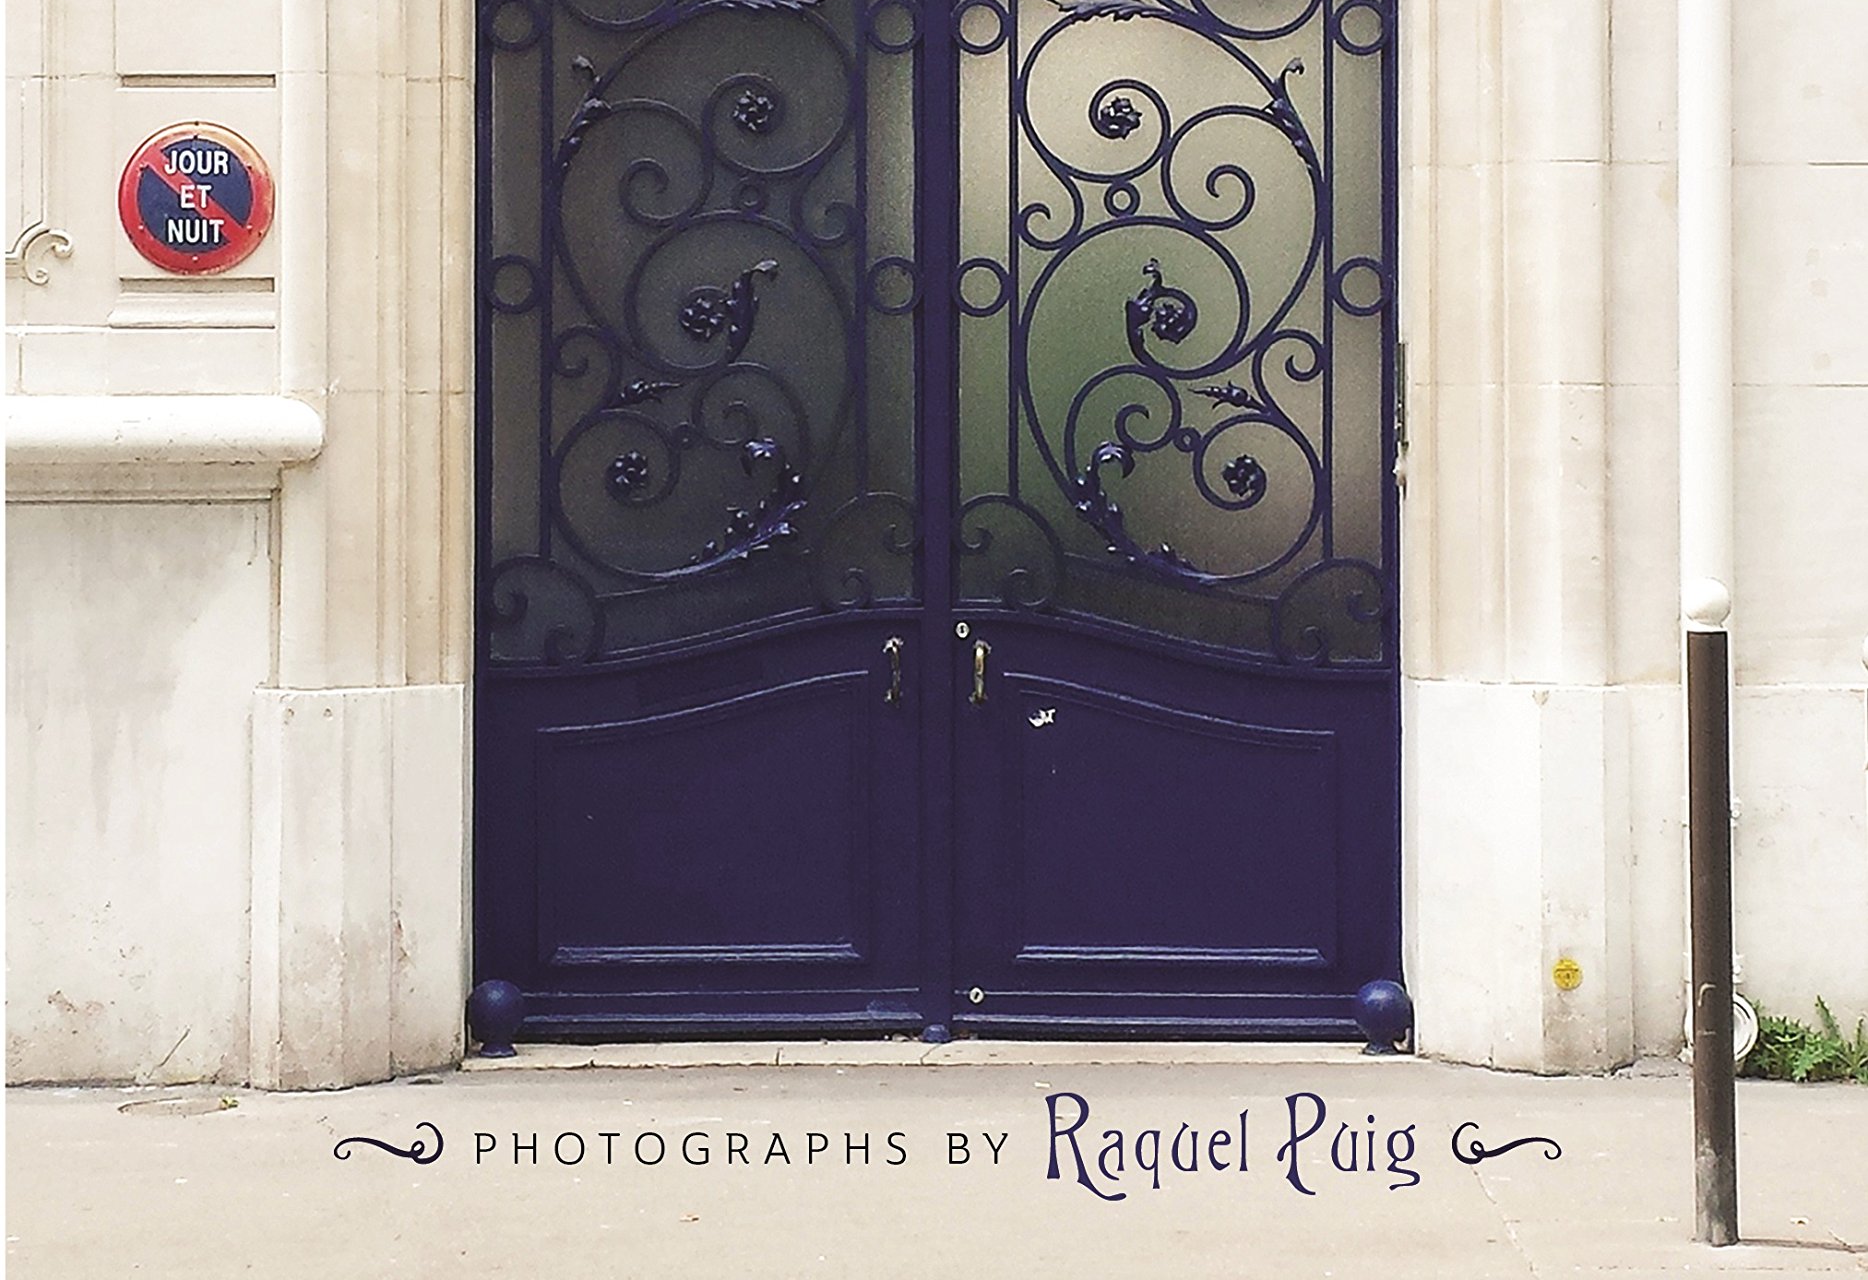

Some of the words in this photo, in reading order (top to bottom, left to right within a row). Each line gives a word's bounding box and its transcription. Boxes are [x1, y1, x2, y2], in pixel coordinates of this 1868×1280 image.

[164, 150, 229, 175] JOUR
[180, 184, 212, 209] ET
[167, 218, 225, 244] NUIT
